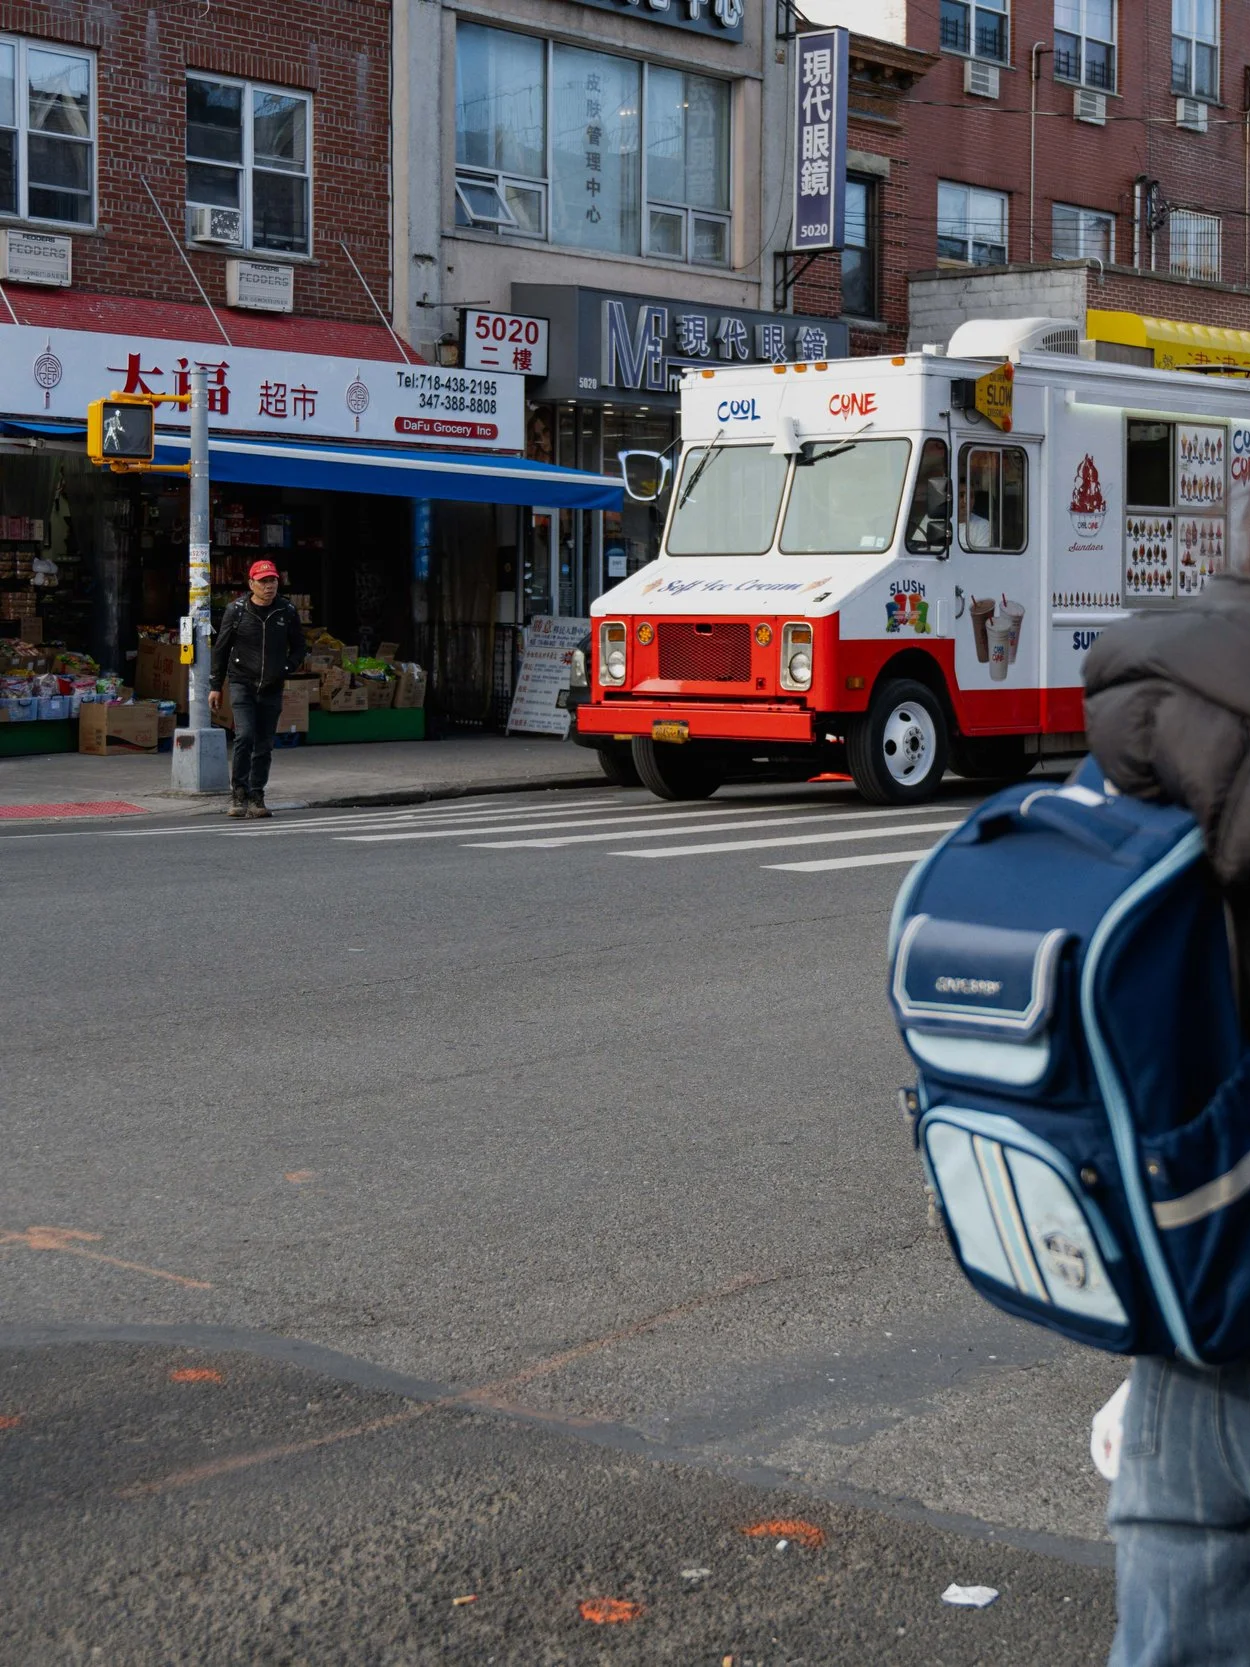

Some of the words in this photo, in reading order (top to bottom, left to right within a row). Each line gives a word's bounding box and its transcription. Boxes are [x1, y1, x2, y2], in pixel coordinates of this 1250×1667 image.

[801, 49, 832, 197] 現代眼鏡
[801, 223, 828, 238] 5020
[9, 243, 66, 259] FEDDERS
[239, 272, 289, 287] FEDDERS
[475, 315, 539, 345] 5020
[679, 314, 828, 365] 現代眼鏡
[480, 346, 533, 372] 二樓
[106, 353, 231, 415] 大福
[259, 380, 319, 421] 超市
[579, 377, 597, 390] 5020
[419, 394, 497, 414] 347-388-8808
[987, 384, 1012, 407] SLOW
[717, 398, 761, 422] COOL
[829, 392, 878, 421] CONE
[403, 420, 430, 431] DaFu
[433, 422, 471, 436] Grocery
[477, 425, 492, 436] Inc
[1068, 542, 1104, 552] Sundaes
[657, 580, 704, 596] Soft
[701, 580, 732, 591] Ice
[735, 580, 803, 591] Cream
[890, 580, 925, 597] SLUSH
[1073, 631, 1104, 650] SUN
